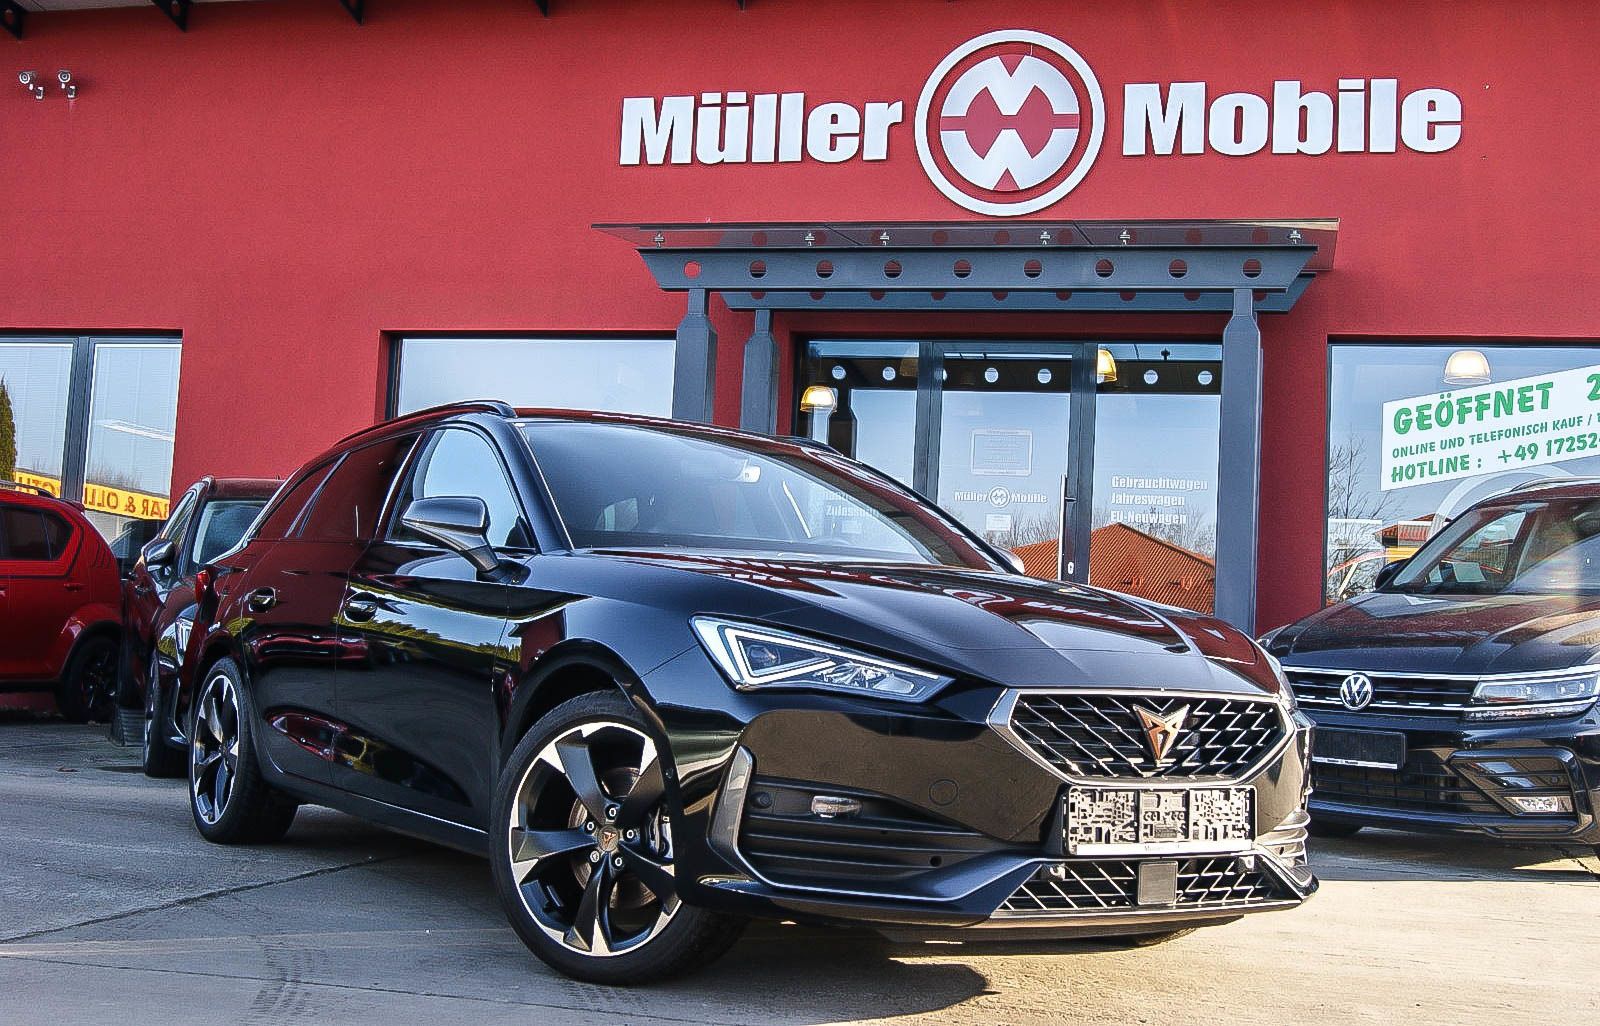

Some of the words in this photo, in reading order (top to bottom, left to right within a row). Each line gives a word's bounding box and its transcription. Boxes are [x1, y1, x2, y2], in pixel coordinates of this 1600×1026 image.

[619, 92, 903, 166] Müller
[1122, 77, 1464, 157] Mobile
[1393, 381, 1554, 435] GEÖFFNET
[1391, 454, 1470, 482] HOTLINE
[1497, 442, 1539, 464] +49
[1546, 432, 1600, 457] 17252
[1392, 442, 1436, 459] ONLINE
[1440, 437, 1465, 450] UND
[1469, 421, 1548, 446] TELEFONISCH
[1552, 415, 1583, 431] KAUF
[1111, 475, 1208, 491] Gebrauchtwagen
[1111, 493, 1185, 507] Jahreswagen
